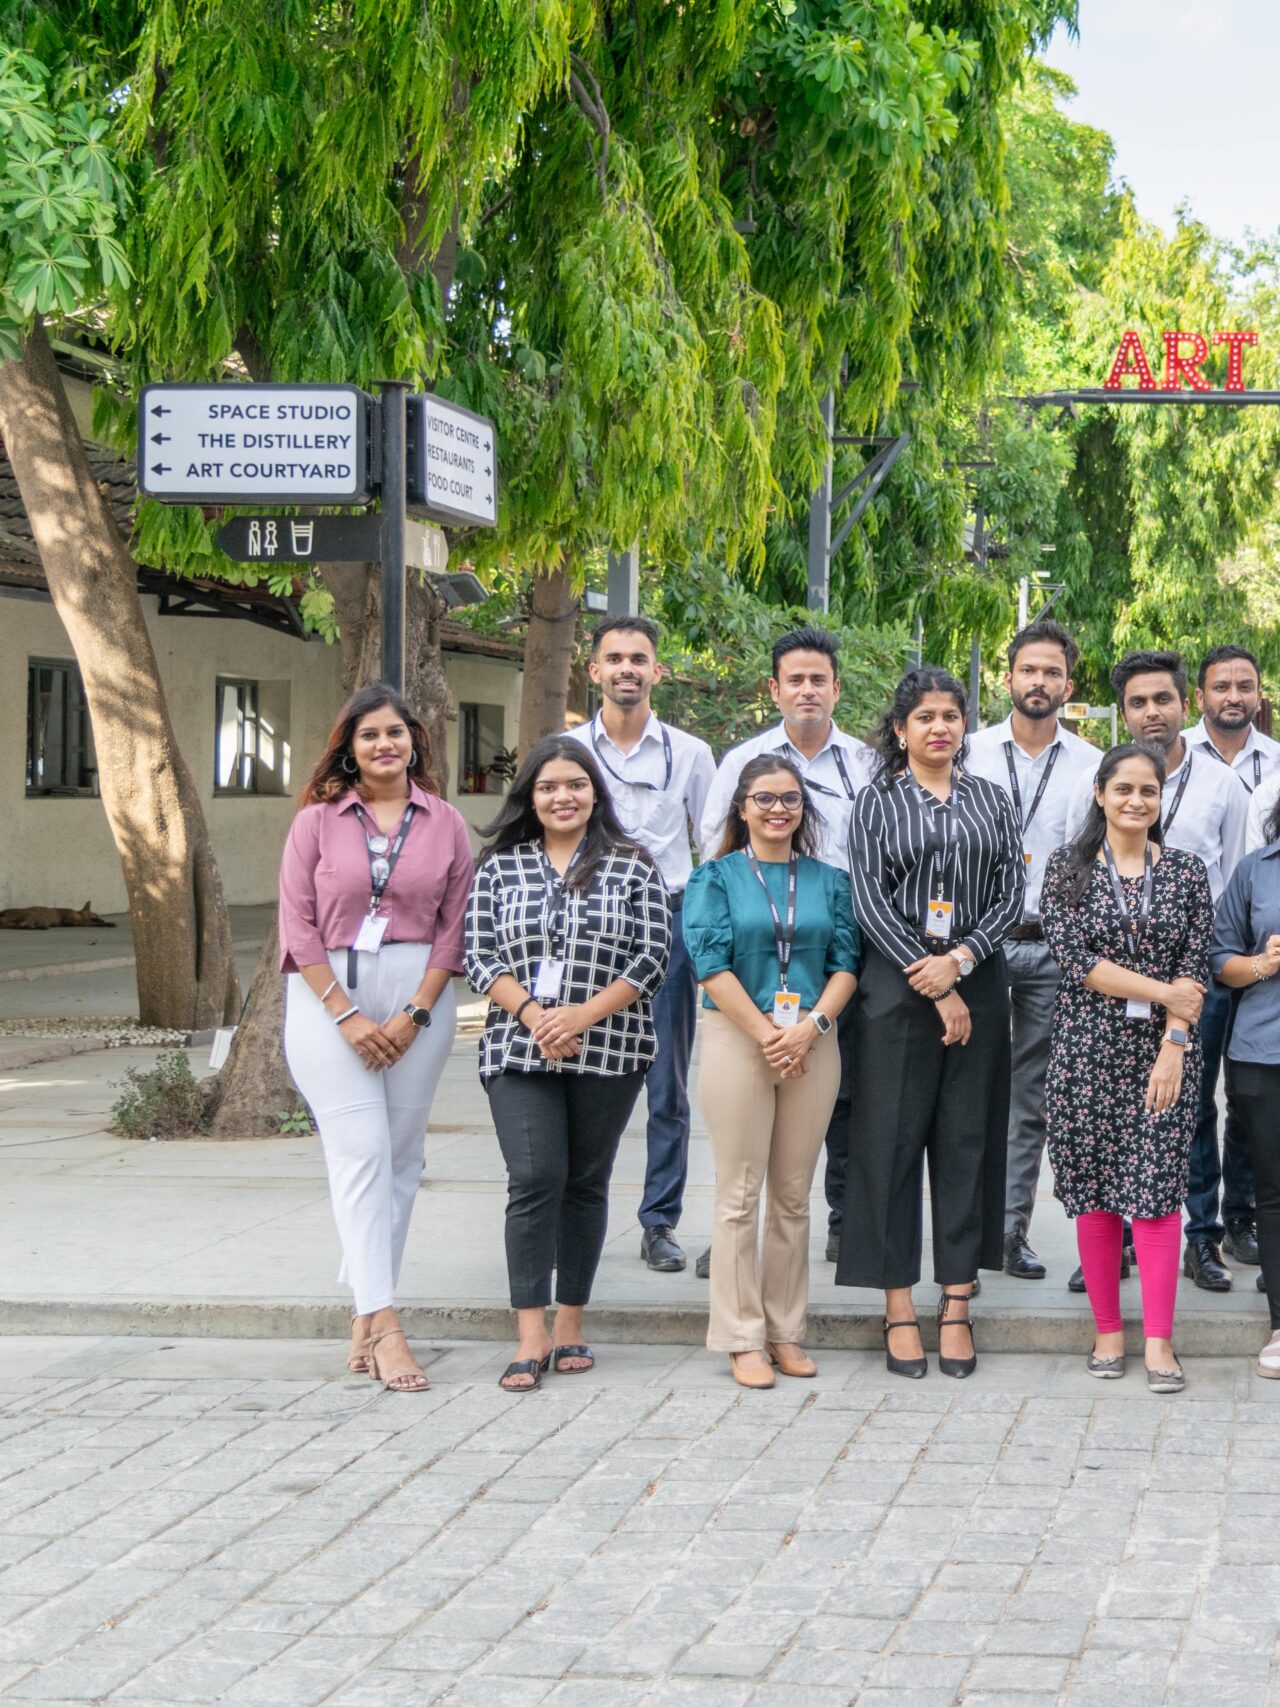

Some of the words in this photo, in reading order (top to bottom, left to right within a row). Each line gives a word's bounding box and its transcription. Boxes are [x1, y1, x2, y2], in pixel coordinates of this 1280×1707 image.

[1104, 331, 1258, 392] ART
[209, 405, 269, 419] SPACE
[278, 405, 350, 420] STUDIO
[198, 434, 235, 448] THE
[244, 434, 350, 449] DISTILLERY
[427, 416, 454, 439] VISITOR
[455, 427, 480, 450] CENTRE
[186, 463, 223, 477] ART
[230, 463, 350, 478] COURTYARD
[427, 443, 475, 474] RESTAURANTS
[428, 472, 448, 491] FOOD
[450, 480, 473, 500] COURT
